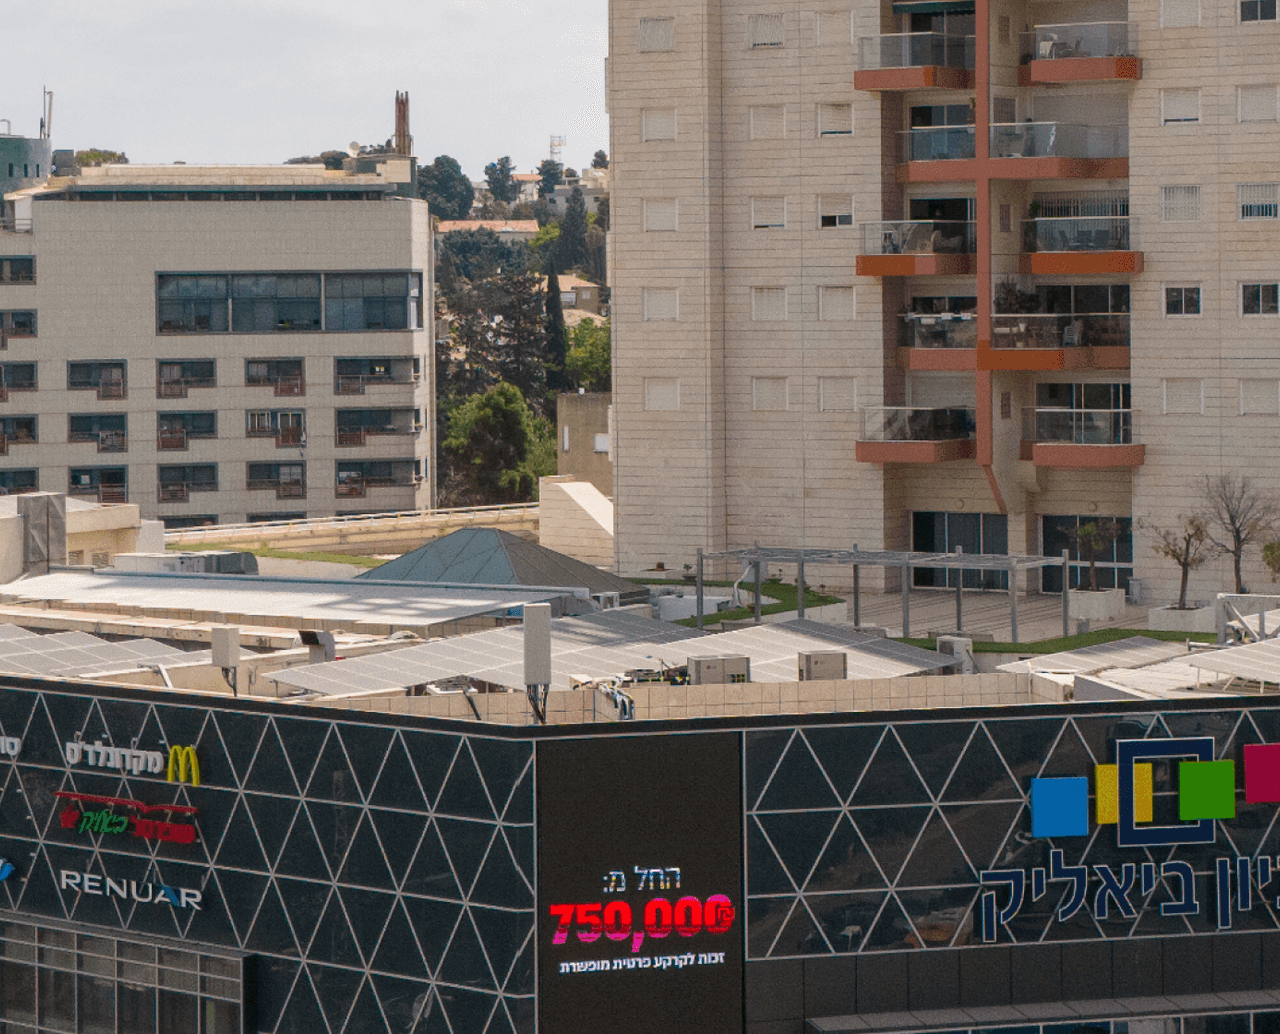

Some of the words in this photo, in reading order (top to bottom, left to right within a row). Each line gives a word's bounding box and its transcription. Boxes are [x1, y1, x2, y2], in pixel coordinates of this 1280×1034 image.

[632, 865, 681, 891] החל
[60, 869, 203, 911] RENUAR
[978, 848, 1200, 945] ביאליק
[559, 958, 611, 974] מופשרת
[613, 956, 652, 969] פרטית
[653, 952, 696, 970] לקרקע
[698, 952, 726, 965] זכות
